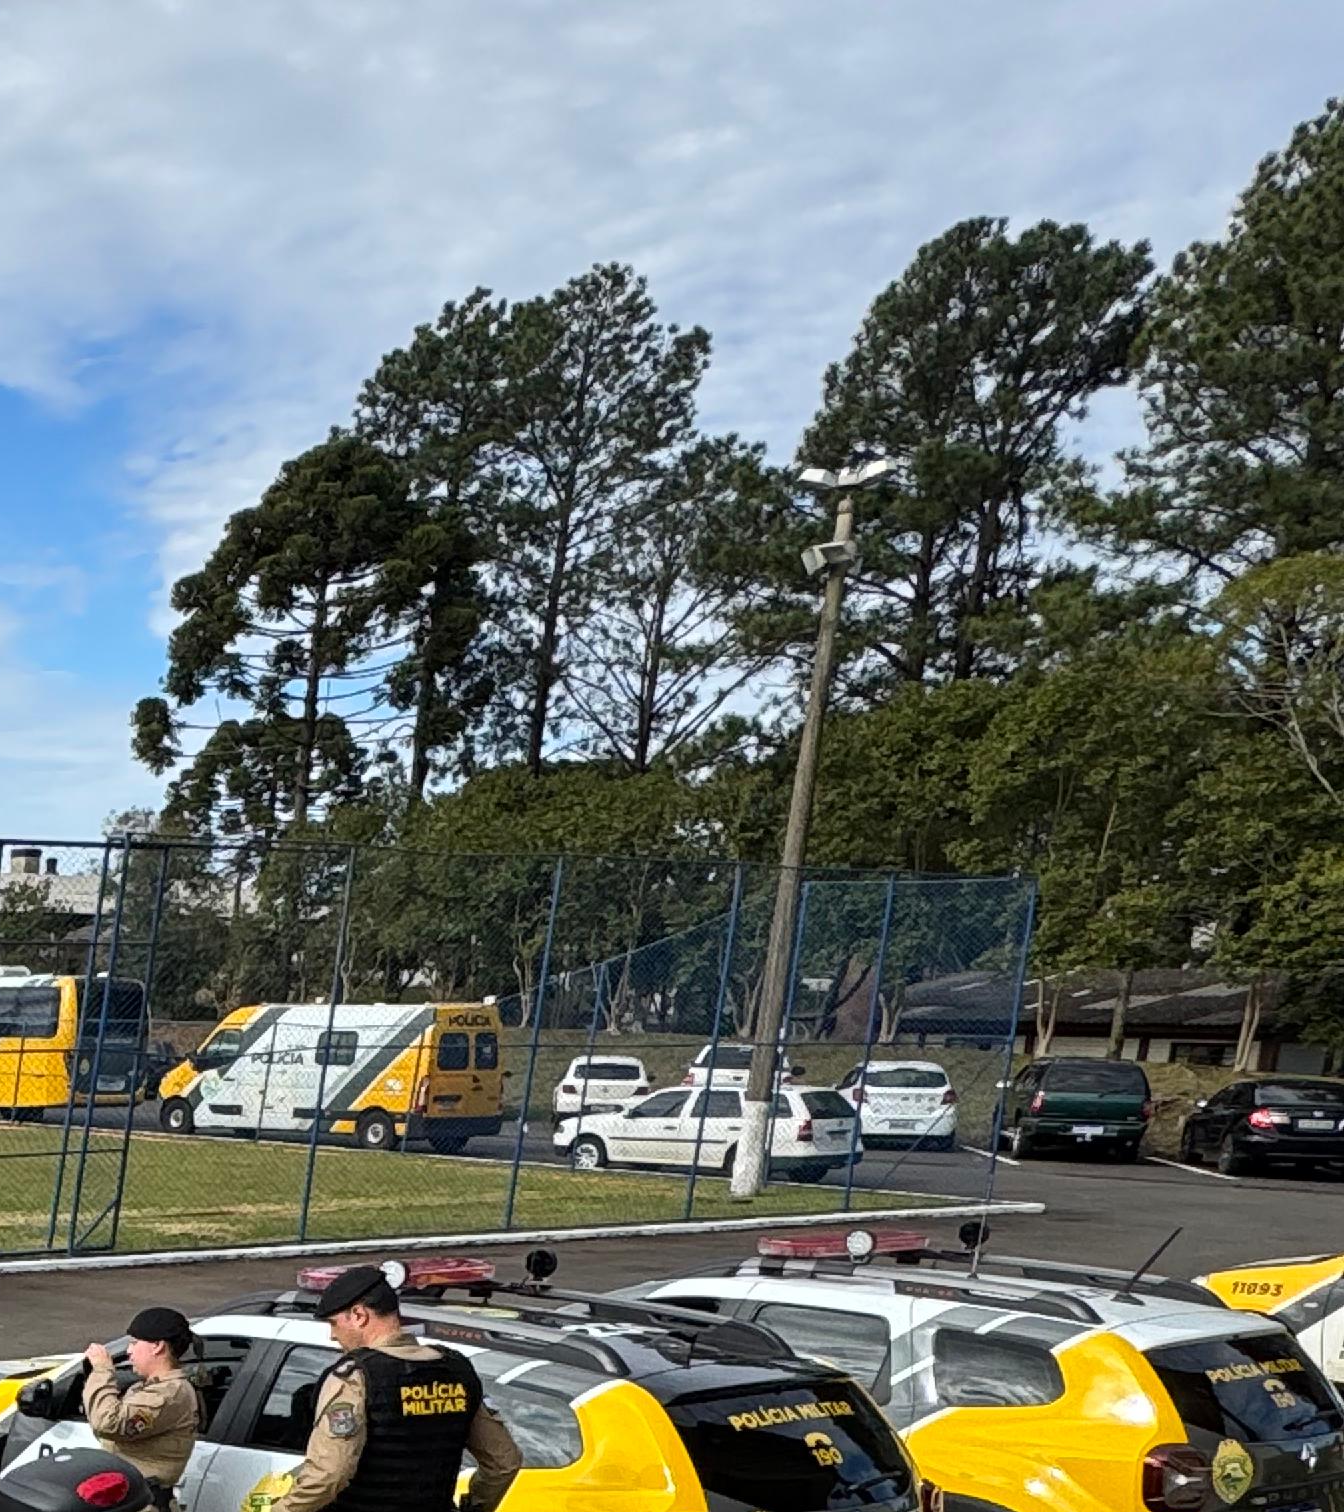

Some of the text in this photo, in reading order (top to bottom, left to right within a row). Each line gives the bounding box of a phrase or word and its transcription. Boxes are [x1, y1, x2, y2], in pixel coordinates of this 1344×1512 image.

[400, 1380, 466, 1400] POLÍCIA
[402, 1398, 467, 1416] MILITAR
[727, 1400, 856, 1431] POLÍCIA MILITAR
[811, 1446, 844, 1466] 190
